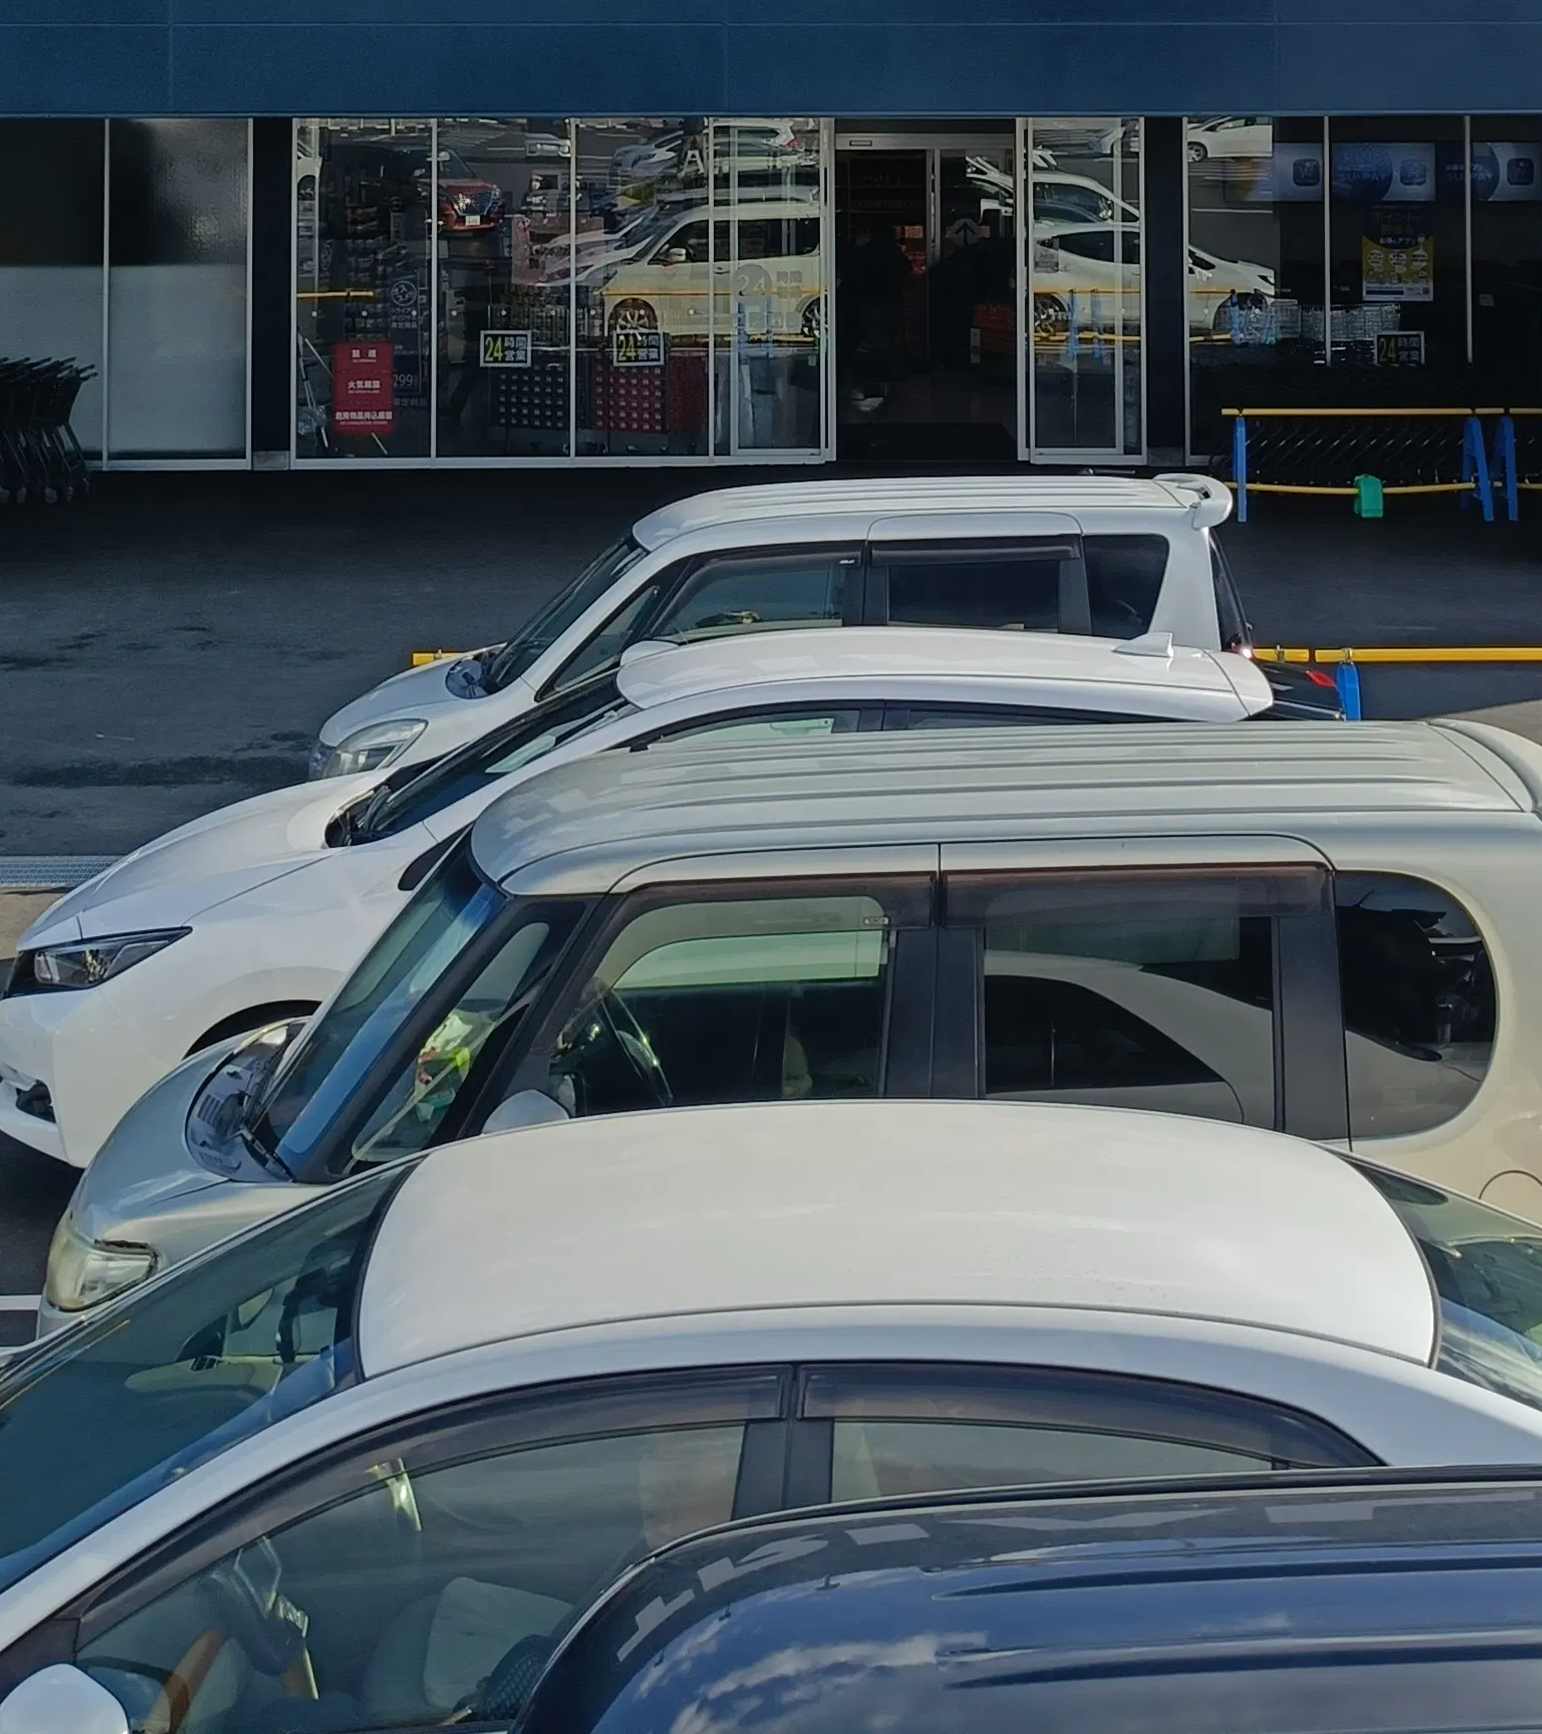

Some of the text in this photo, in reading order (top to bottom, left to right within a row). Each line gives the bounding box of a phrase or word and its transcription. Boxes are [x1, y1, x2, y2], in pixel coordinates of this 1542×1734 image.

[485, 336, 503, 361] 24
[618, 335, 636, 361] 24
[1379, 337, 1397, 362] 24
